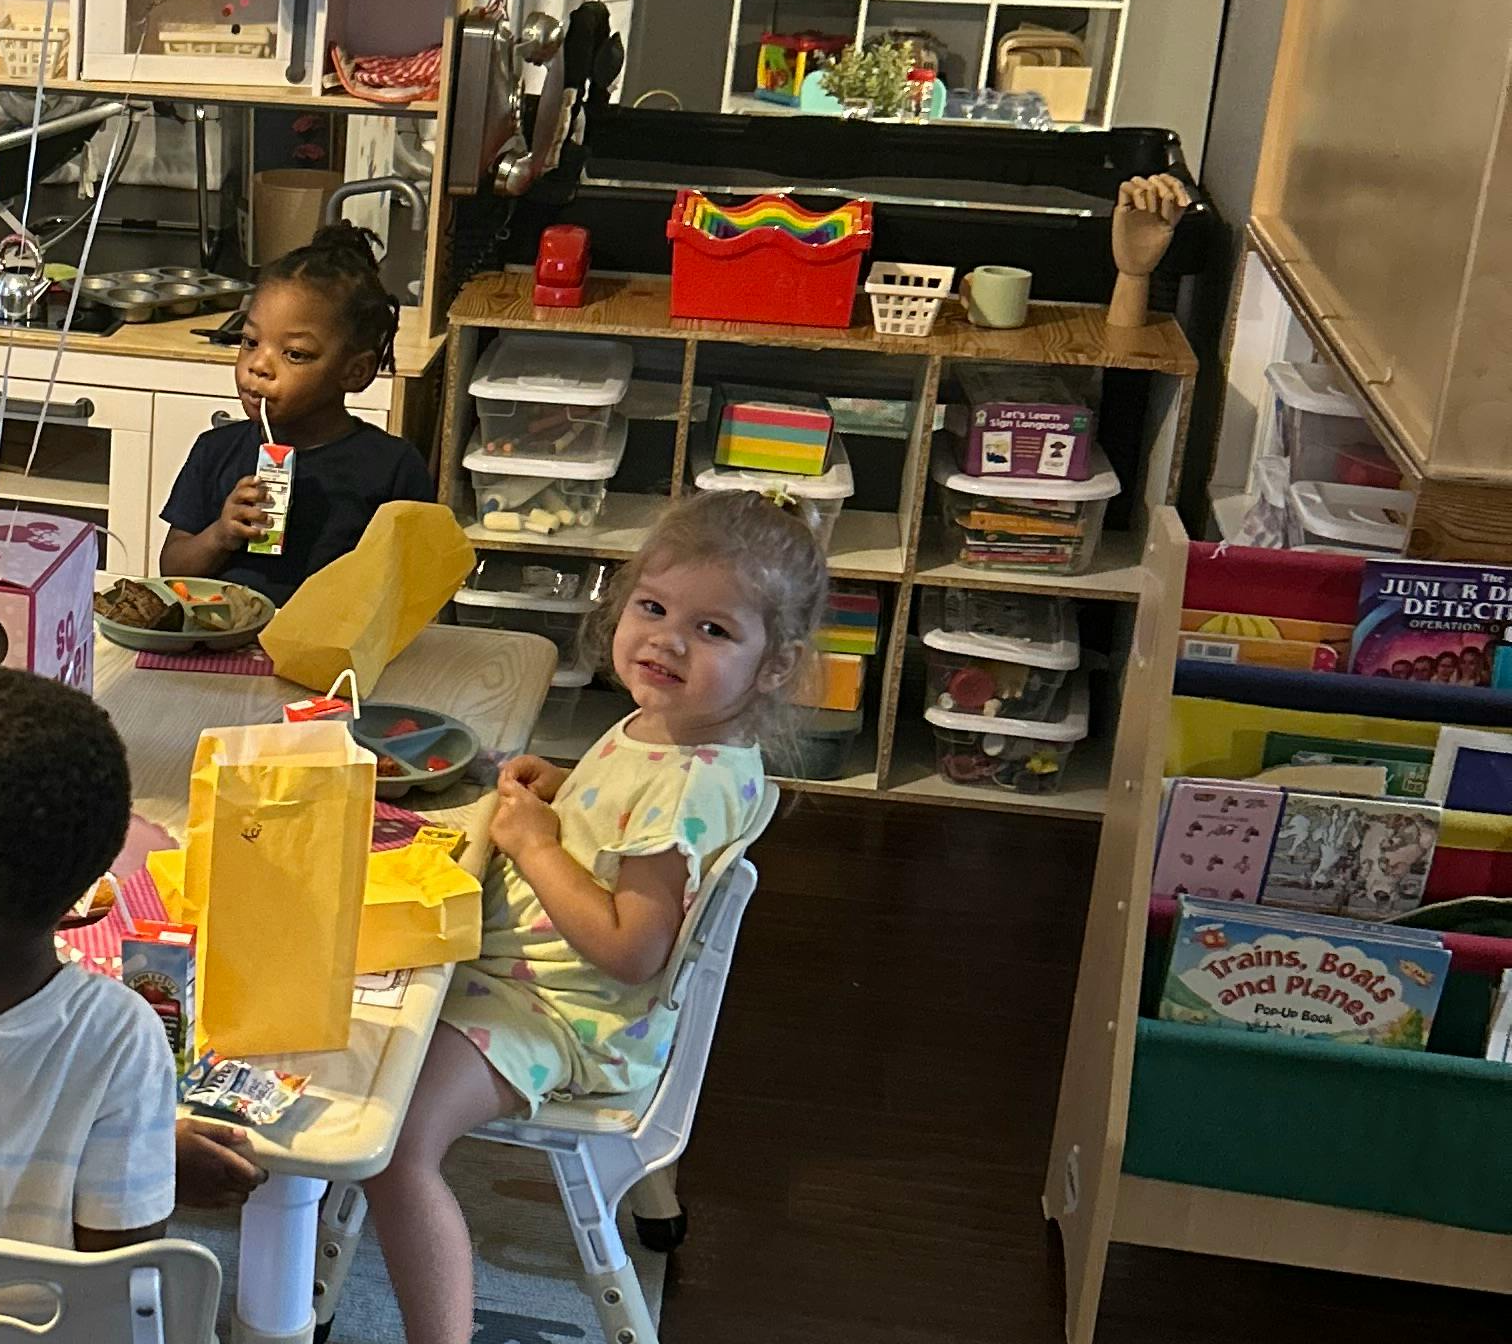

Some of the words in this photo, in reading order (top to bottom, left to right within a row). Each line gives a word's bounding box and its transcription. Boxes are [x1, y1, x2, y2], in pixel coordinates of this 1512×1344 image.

[1000, 410, 1026, 419] Let's
[1028, 412, 1060, 420] Learn
[989, 419, 1013, 428] Sign
[1015, 421, 1070, 431] Language
[1202, 945, 1307, 980] Trains,
[1315, 952, 1396, 1004] Boats
[1217, 975, 1277, 1005] and
[1284, 976, 1375, 1026] Planes
[1301, 1010, 1333, 1024] Book
